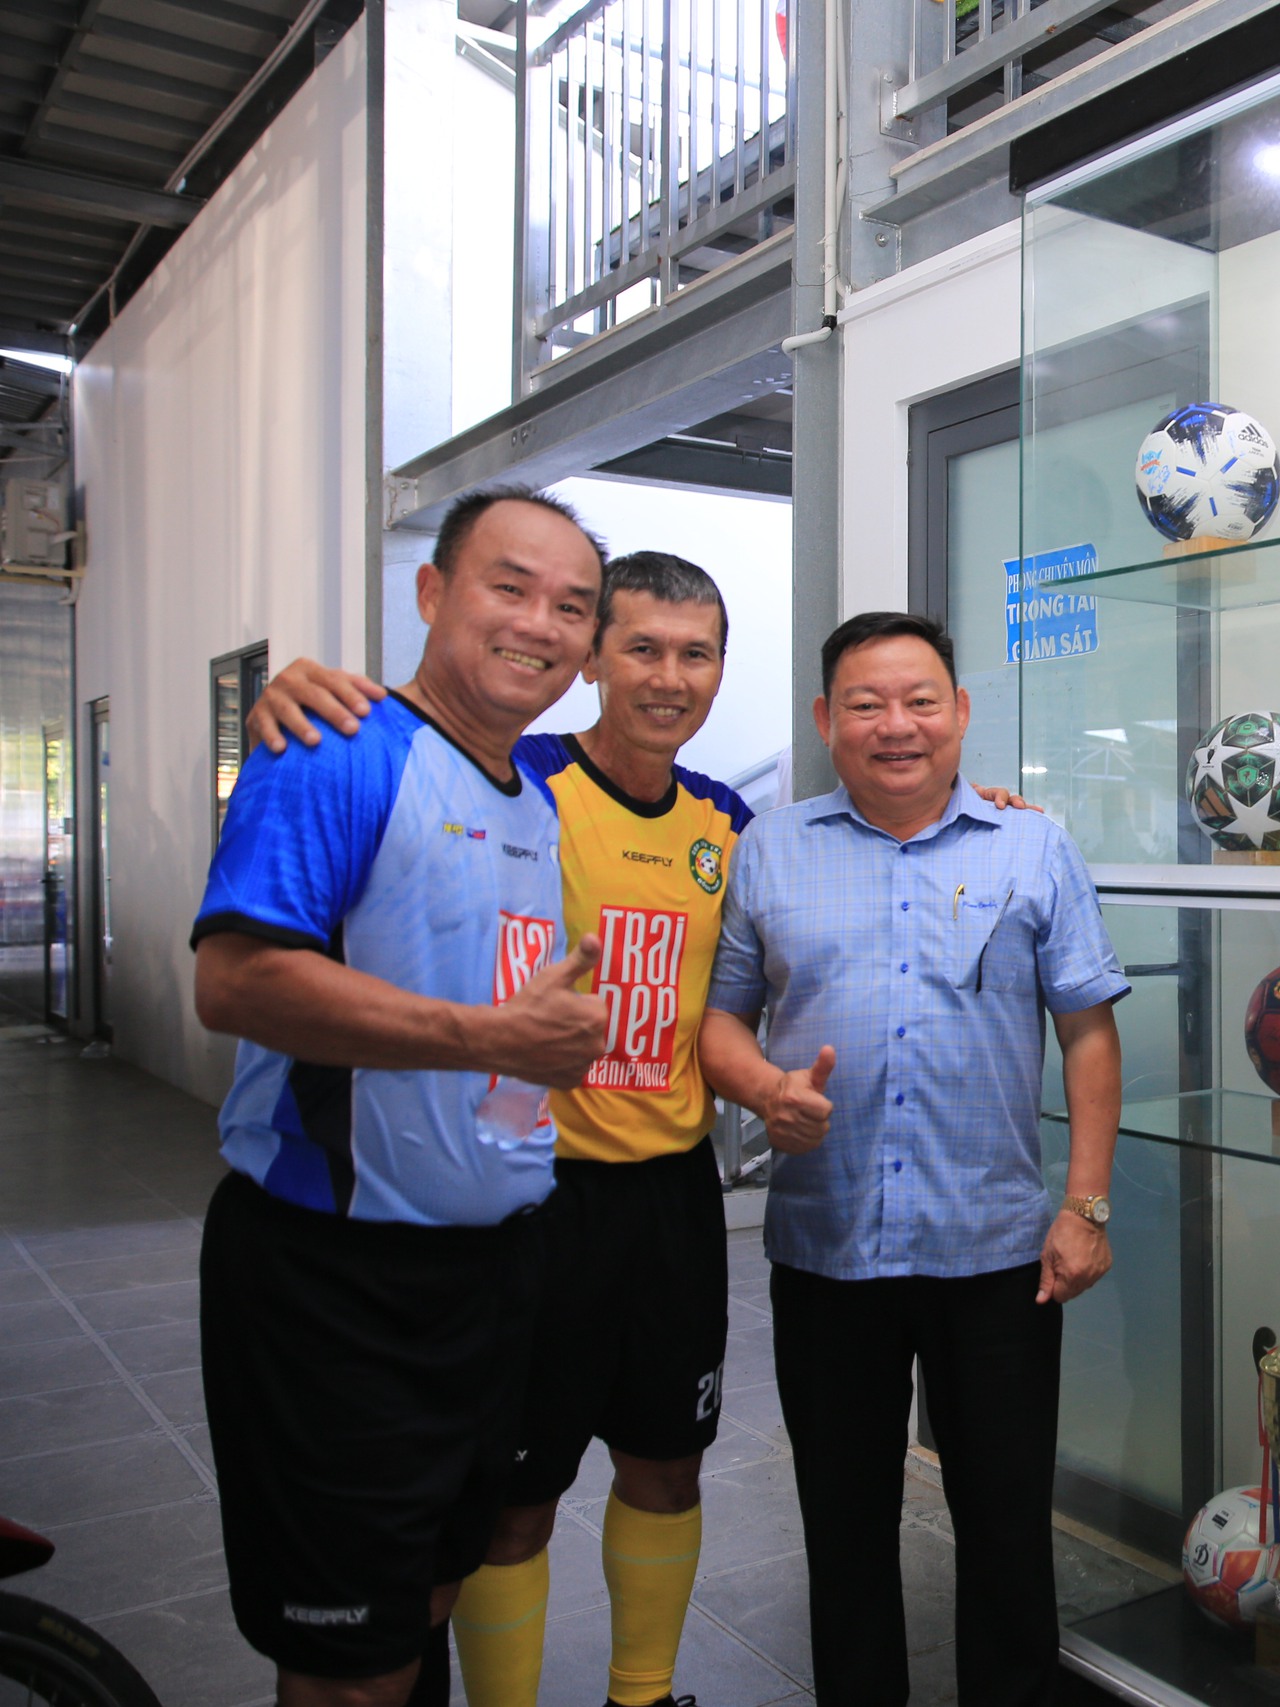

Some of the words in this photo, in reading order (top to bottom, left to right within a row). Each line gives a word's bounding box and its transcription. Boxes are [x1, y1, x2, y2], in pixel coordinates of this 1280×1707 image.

[1237, 433, 1269, 449] adidas
[1012, 631, 1056, 662] GIÁM
[1060, 624, 1092, 655] SÁT
[622, 849, 673, 867] KEEPFLY
[283, 1604, 367, 1625] KEEPFLY
